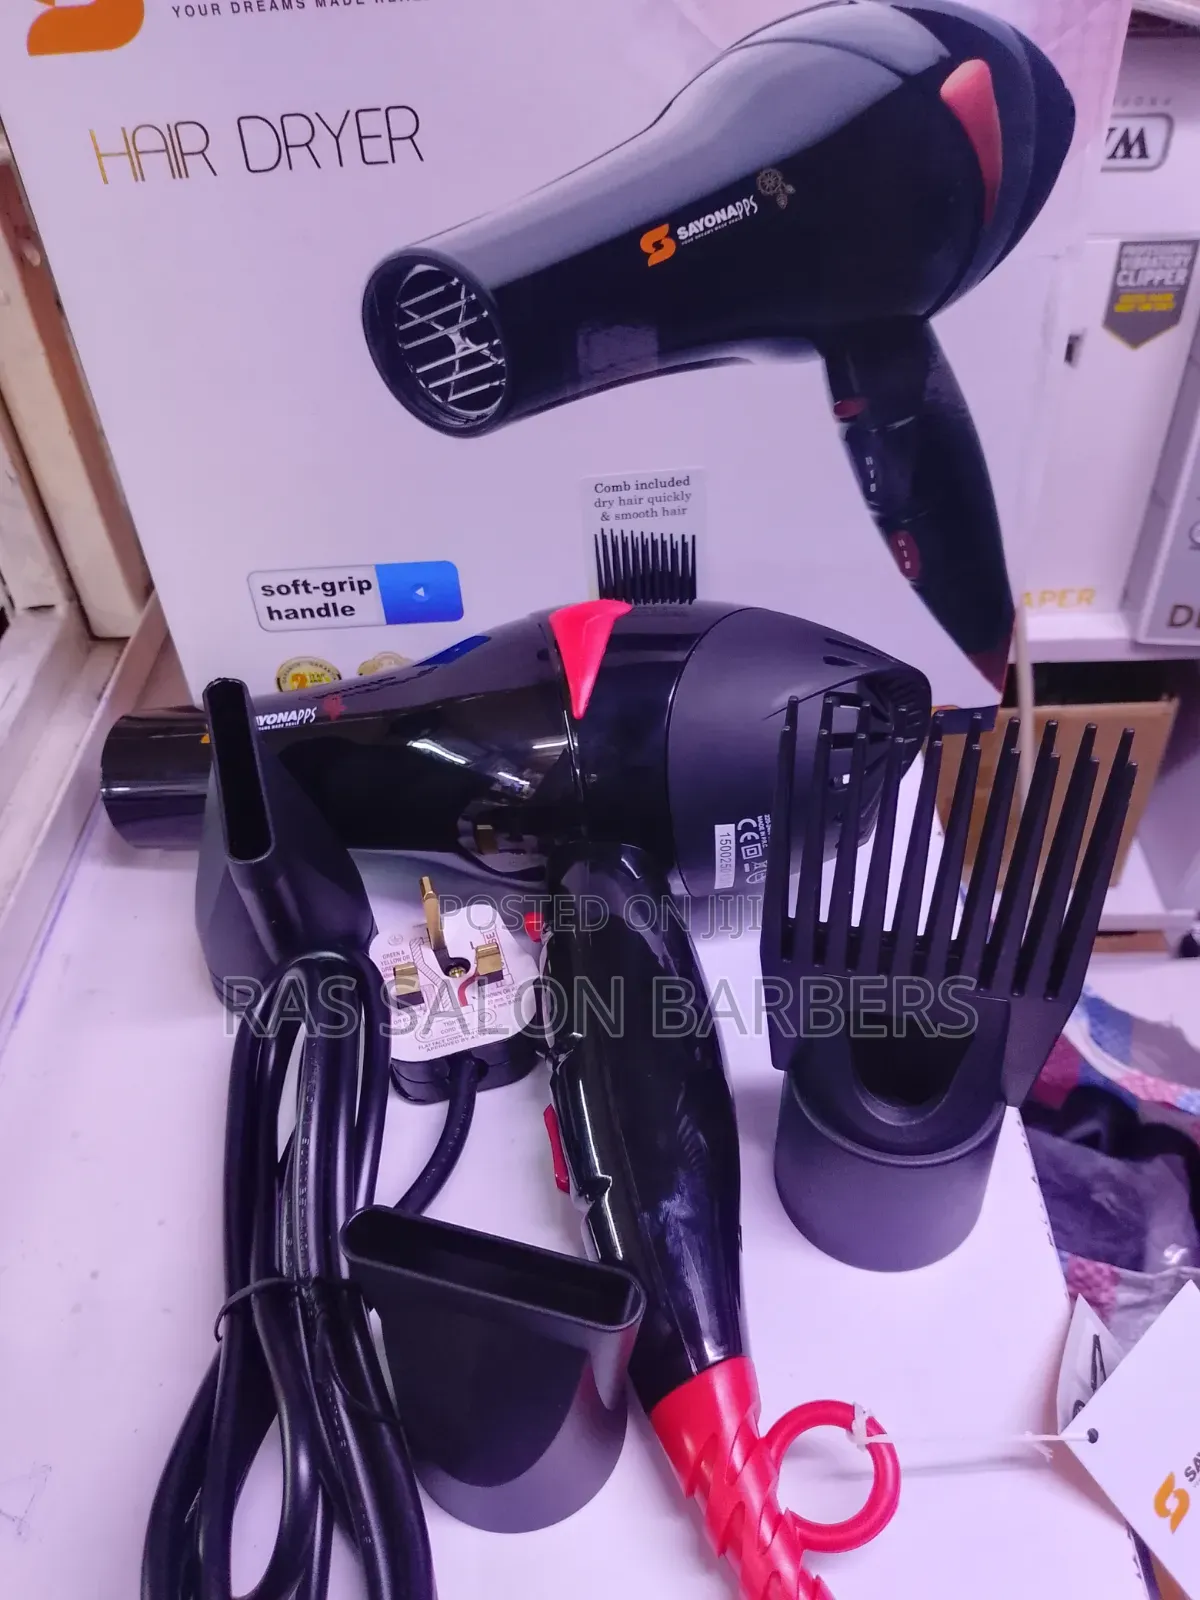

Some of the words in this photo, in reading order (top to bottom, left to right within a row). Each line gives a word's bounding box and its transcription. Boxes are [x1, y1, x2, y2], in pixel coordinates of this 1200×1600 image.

[171, 4, 221, 18] YOUR
[231, 0, 306, 14] DREAMS
[89, 121, 218, 185] HAIR
[237, 105, 424, 174] DRYER
[1117, 268, 1188, 287] CLIPPER
[594, 481, 631, 494] Comb
[635, 476, 691, 491] included
[594, 497, 615, 509] dry
[618, 494, 644, 507] hair
[647, 490, 692, 506] quickly
[600, 511, 611, 522] &
[614, 506, 659, 521] smooth
[662, 504, 688, 517] hair
[261, 576, 373, 598] soft-grip
[266, 602, 356, 621] handle
